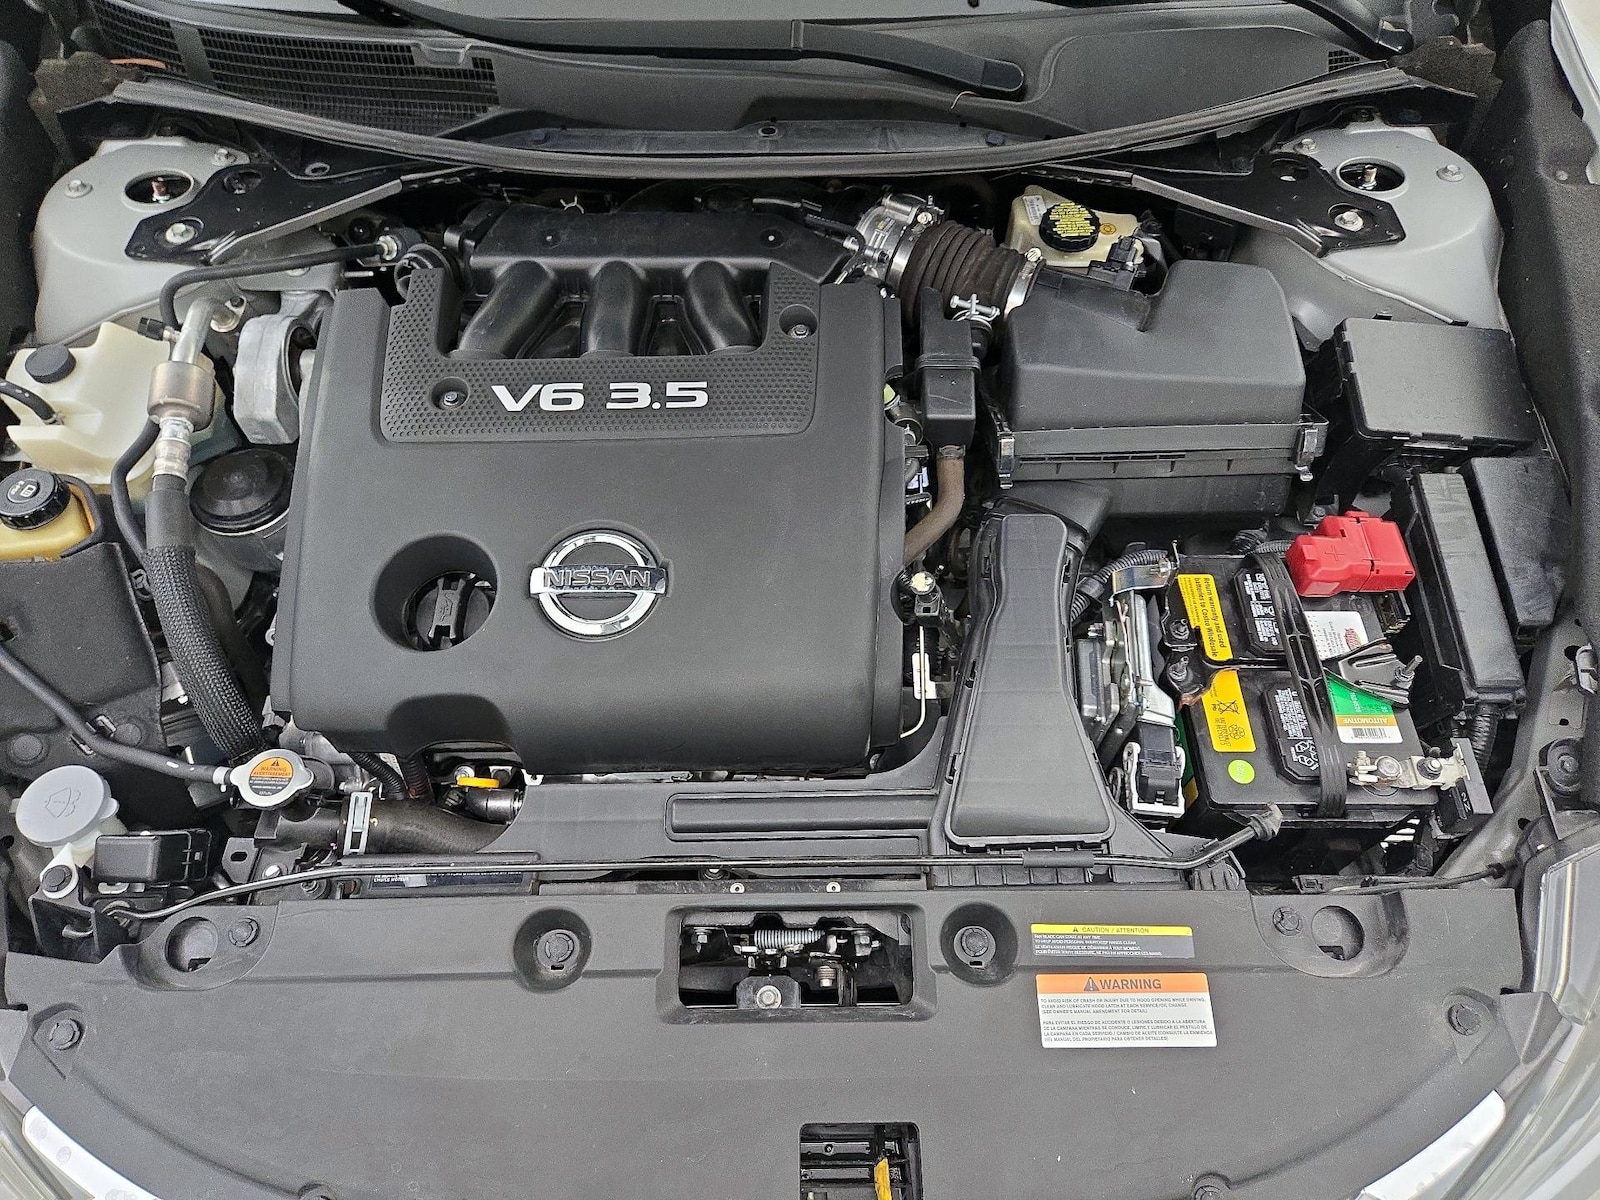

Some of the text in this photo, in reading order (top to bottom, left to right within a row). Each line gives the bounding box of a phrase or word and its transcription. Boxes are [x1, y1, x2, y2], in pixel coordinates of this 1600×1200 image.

[491, 381, 708, 412] V6 3.5
[543, 568, 650, 588] NISSAN
[1194, 577, 1205, 601] batteries
[1201, 608, 1212, 627] Costco
[1203, 577, 1227, 648] Return warranty and used
[1206, 627, 1219, 658] Wholesale
[1100, 979, 1161, 989] WARNING
